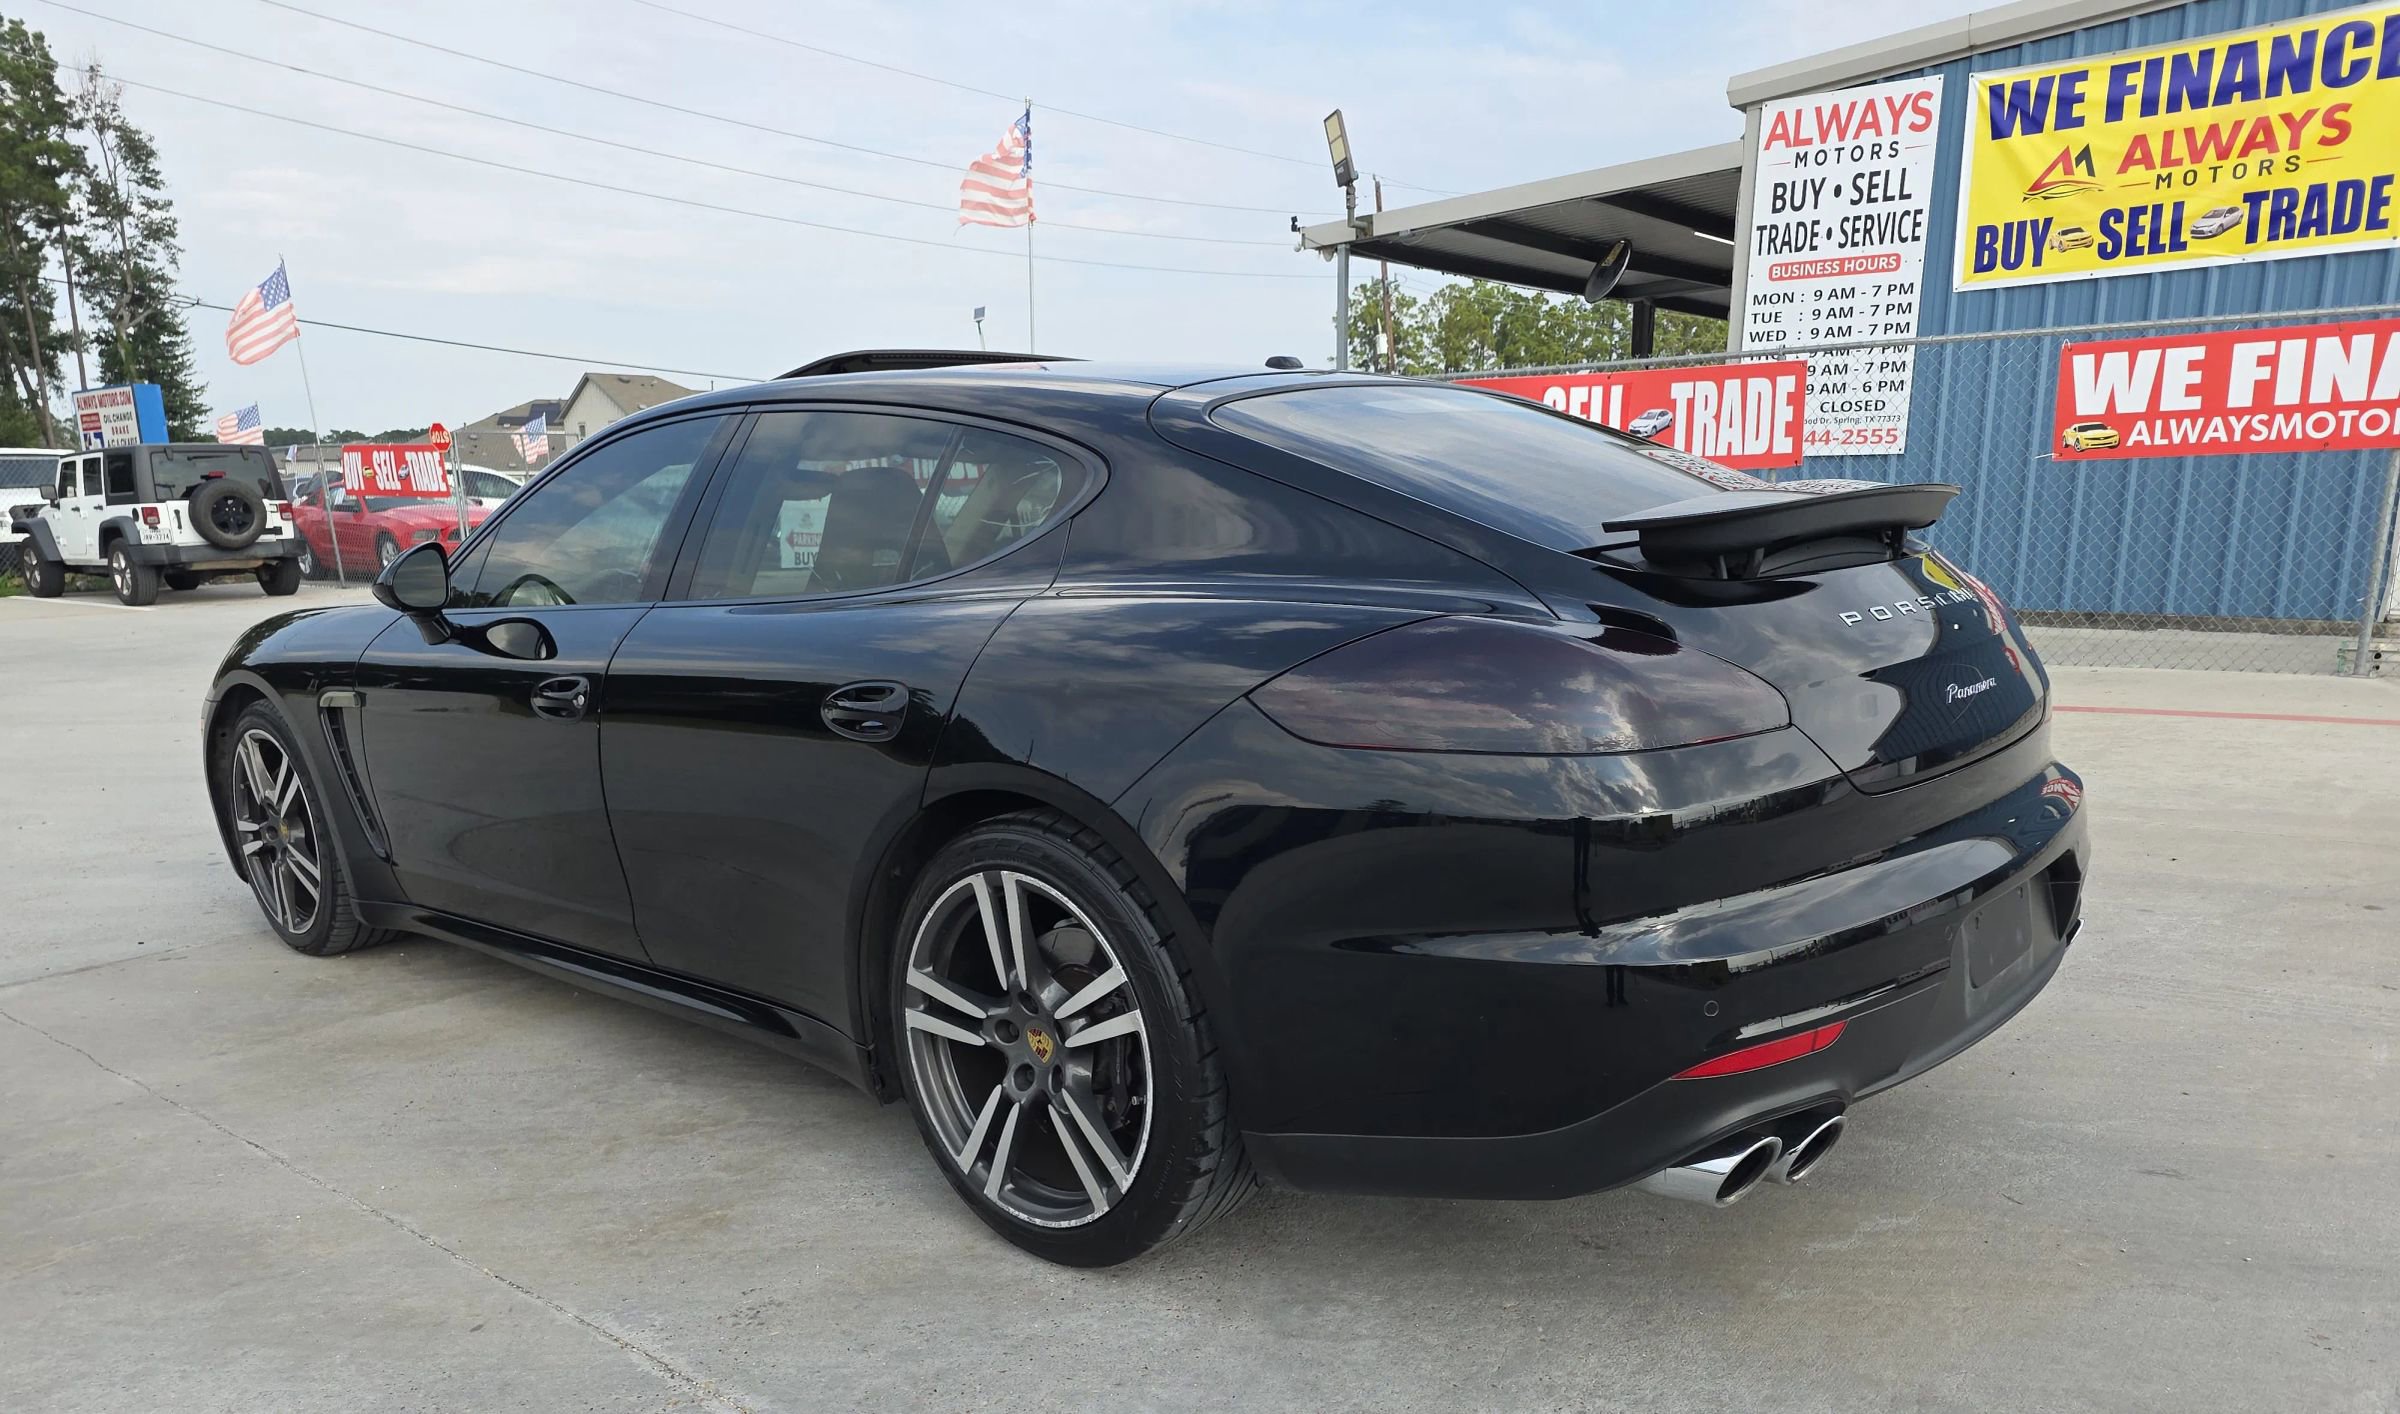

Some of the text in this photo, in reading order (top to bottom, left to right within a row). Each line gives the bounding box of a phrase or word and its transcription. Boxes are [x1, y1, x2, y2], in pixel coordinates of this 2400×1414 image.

[1988, 69, 2089, 141] WE
[1764, 91, 1934, 150] ALWAYS
[2116, 102, 2352, 175] ALWAYS
[1794, 141, 1899, 168] MOTORS
[2155, 154, 2301, 190] MOTORS
[1771, 167, 1912, 214] BUY SELL
[1756, 209, 1923, 256] TRADE SERVICE
[1973, 173, 2395, 274] BUY SELL TRADE
[1771, 256, 1897, 279] BUSINESS HOURS
[1753, 292, 1795, 306] MON
[1813, 289, 1823, 301] 9
[1827, 287, 1856, 300] AM
[1872, 284, 1882, 297] 7
[1887, 282, 1914, 296] PM
[1751, 311, 1782, 324] TUE
[1812, 308, 1821, 320] 9
[1825, 306, 1854, 320] AM
[1870, 304, 1880, 317] 7
[1885, 302, 1912, 316] PM
[1750, 330, 1787, 343] WED
[1810, 327, 1820, 340] 9
[1824, 325, 1852, 339] AM
[1868, 323, 1878, 336] 7
[1883, 321, 1911, 335] PM
[1807, 365, 1816, 377] 9
[1820, 363, 1848, 376] AM
[1865, 362, 1874, 374] 7
[1880, 360, 1906, 373] PM
[2072, 345, 2206, 416] WE
[1806, 384, 1814, 395] 9
[1819, 382, 1846, 395] AM
[1863, 381, 1872, 393] 6
[1878, 380, 1904, 392] PM
[113, 411, 133, 422] CHANGE
[1670, 375, 1796, 457] TRADE
[1820, 399, 1886, 413] CLOSED
[1865, 415, 1875, 423] TX
[1877, 415, 1901, 423] 77373
[112, 425, 129, 435] BRAKE
[1804, 428, 1898, 446] 44-2555
[2125, 407, 2400, 446] ALWAYSMOTO
[344, 451, 447, 491] BUY SELL TRADE
[1947, 677, 1996, 704] Panamera
